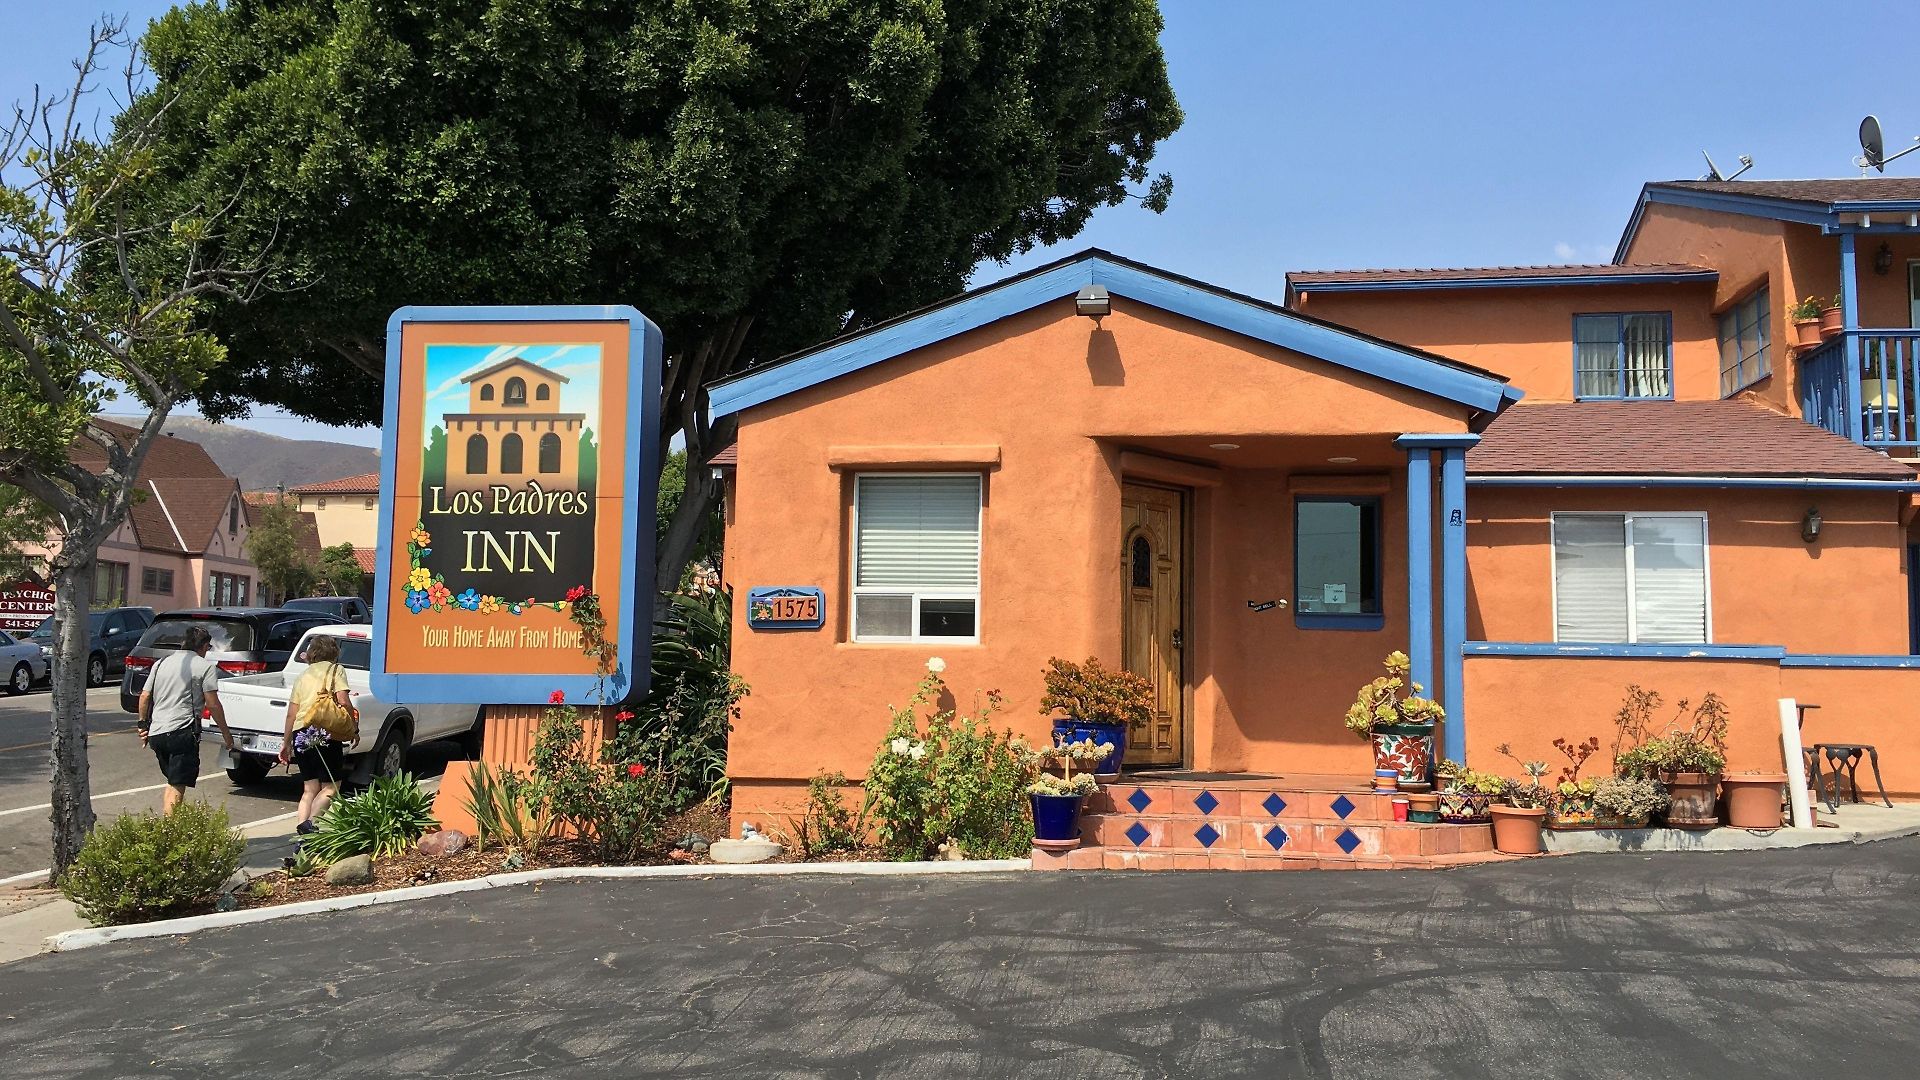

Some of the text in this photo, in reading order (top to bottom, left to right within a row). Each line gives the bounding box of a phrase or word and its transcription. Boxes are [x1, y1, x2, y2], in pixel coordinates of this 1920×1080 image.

[429, 481, 588, 515] Los Padres
[460, 530, 561, 574] INN
[0, 601, 54, 611] CENTER
[774, 599, 817, 618] 1575
[422, 625, 584, 649] YOUR HOME AWAY FROM HOME
